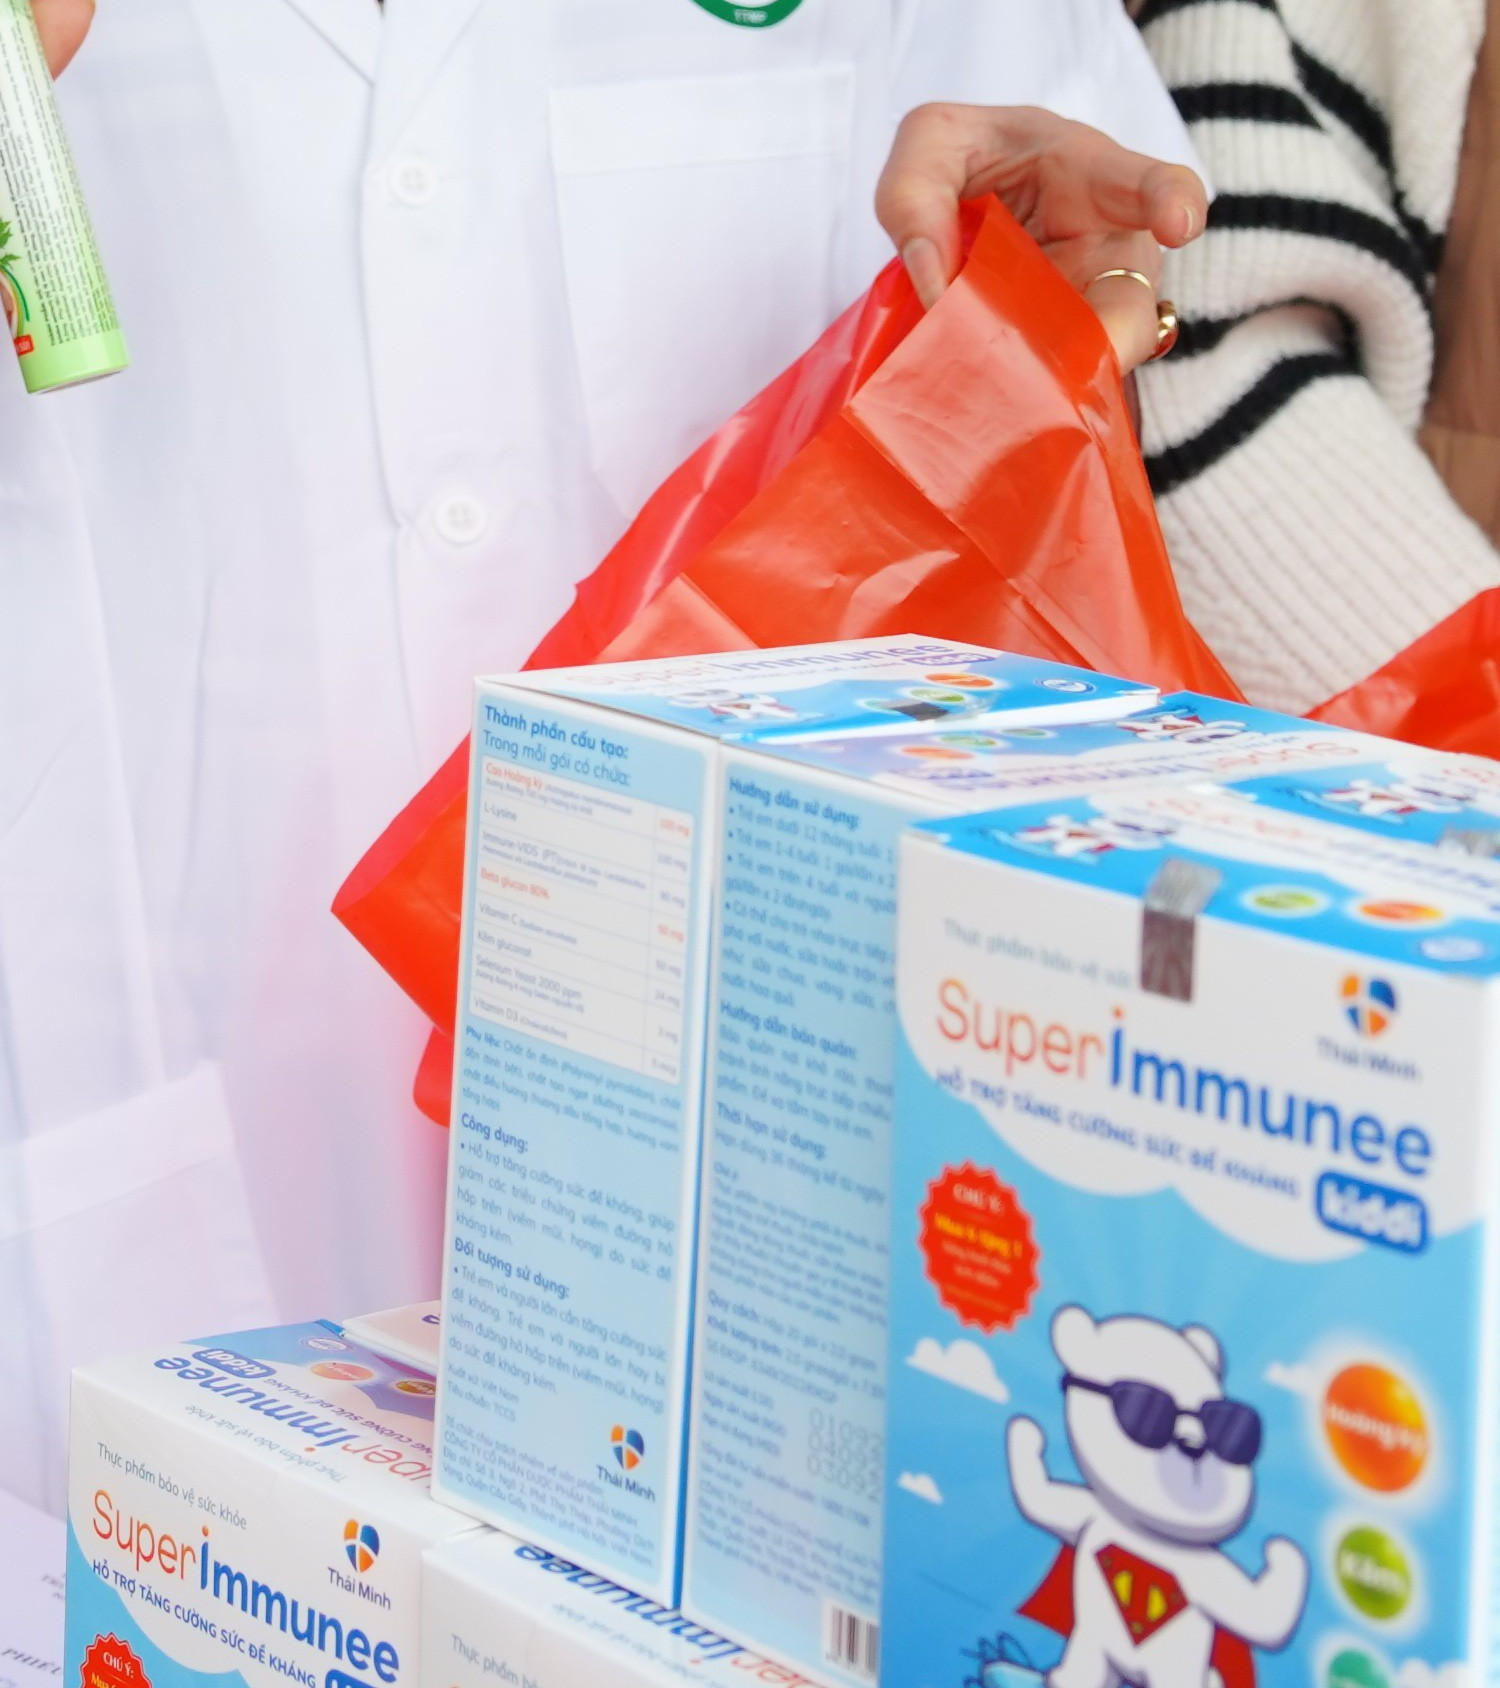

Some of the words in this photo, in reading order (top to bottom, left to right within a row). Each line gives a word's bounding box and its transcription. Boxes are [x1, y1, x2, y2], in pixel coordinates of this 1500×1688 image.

[484, 704, 527, 733] Thành
[530, 718, 567, 745] phần
[570, 727, 597, 751] cấu
[482, 730, 518, 758] Trong
[522, 741, 546, 763] mỗi
[549, 750, 570, 773] gói
[573, 755, 591, 776] có
[460, 1111, 491, 1140] Công
[493, 1126, 528, 1154] dụng:
[969, 1077, 1007, 1112] TRỢ
[1012, 1090, 1064, 1129] TĂNG
[1067, 1108, 1140, 1151] CƯỜNG
[1143, 1131, 1184, 1165] SỨC
[1222, 1158, 1301, 1202] KHÁNG
[454, 1236, 474, 1257] Đối
[476, 1248, 512, 1276] tượng
[533, 1271, 570, 1300] dụng:
[96, 1441, 124, 1471] Thực
[124, 1455, 156, 1486] phẩm
[158, 1475, 180, 1497] bảo
[181, 1487, 196, 1508] vệ
[197, 1492, 217, 1517] sức
[219, 1502, 249, 1531] khỏe
[594, 1462, 623, 1490] Thái
[624, 1475, 657, 1504] Minh
[326, 1565, 356, 1595] Thái
[357, 1580, 392, 1611] Minh
[92, 1555, 110, 1580] HỖ
[113, 1569, 138, 1597] TRỢ
[138, 1581, 172, 1616] TĂNG
[173, 1600, 217, 1640] CƯỜNG
[220, 1621, 246, 1654] SỨC
[249, 1638, 267, 1666] ĐỀ
[268, 1650, 317, 1688] KHÁNG
[103, 1651, 123, 1672] CHÚ
[124, 1661, 134, 1679] Ý:
[451, 1632, 482, 1664] Thực
